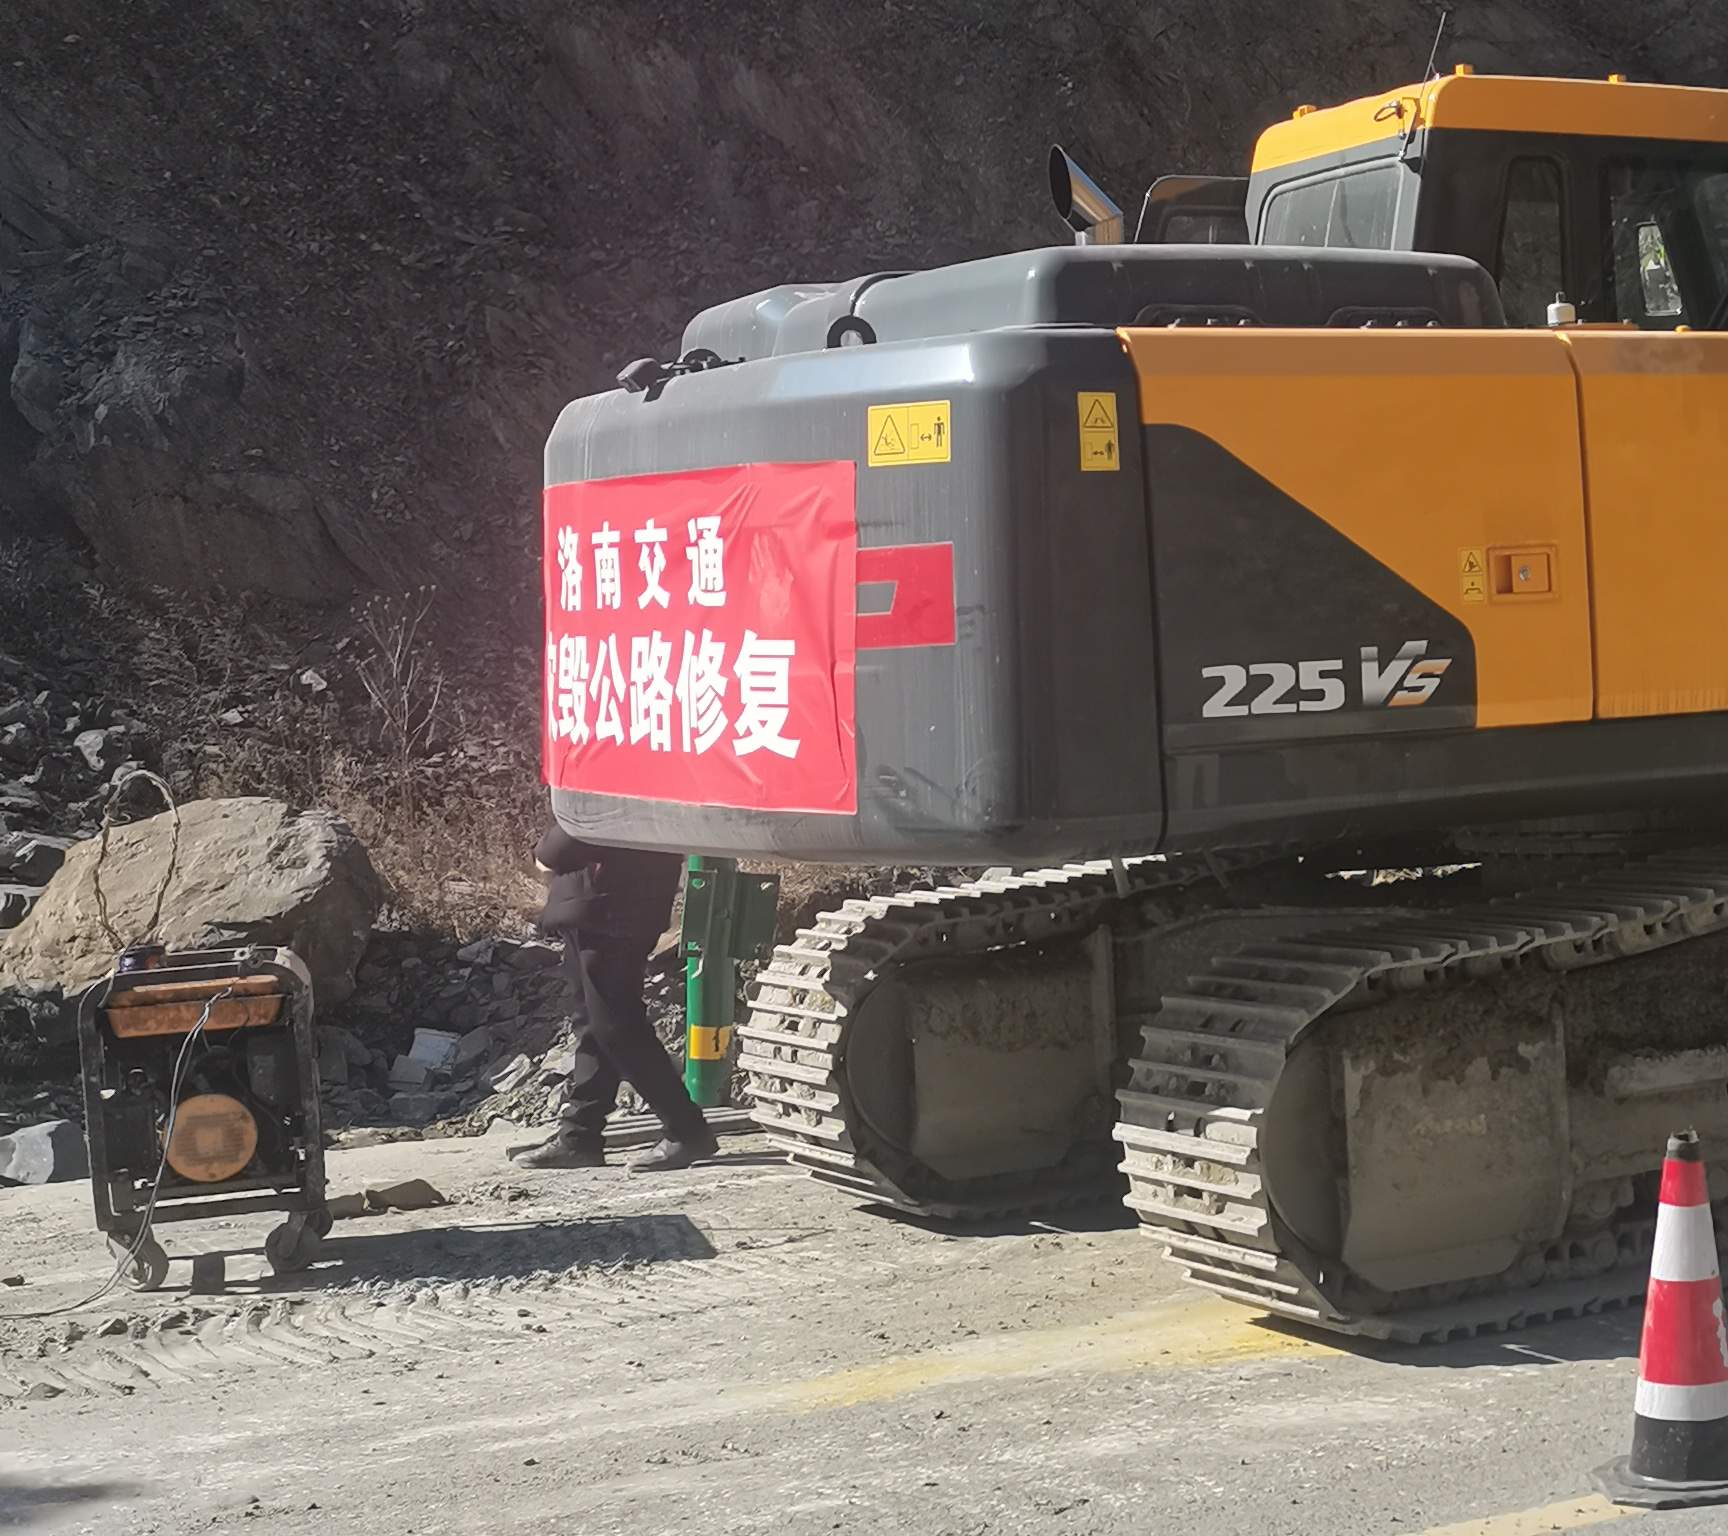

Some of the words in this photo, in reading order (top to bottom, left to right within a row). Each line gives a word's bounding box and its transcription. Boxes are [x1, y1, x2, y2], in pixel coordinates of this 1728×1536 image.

[557, 516, 727, 611] 洛南交通
[1201, 659, 1346, 718] 225
